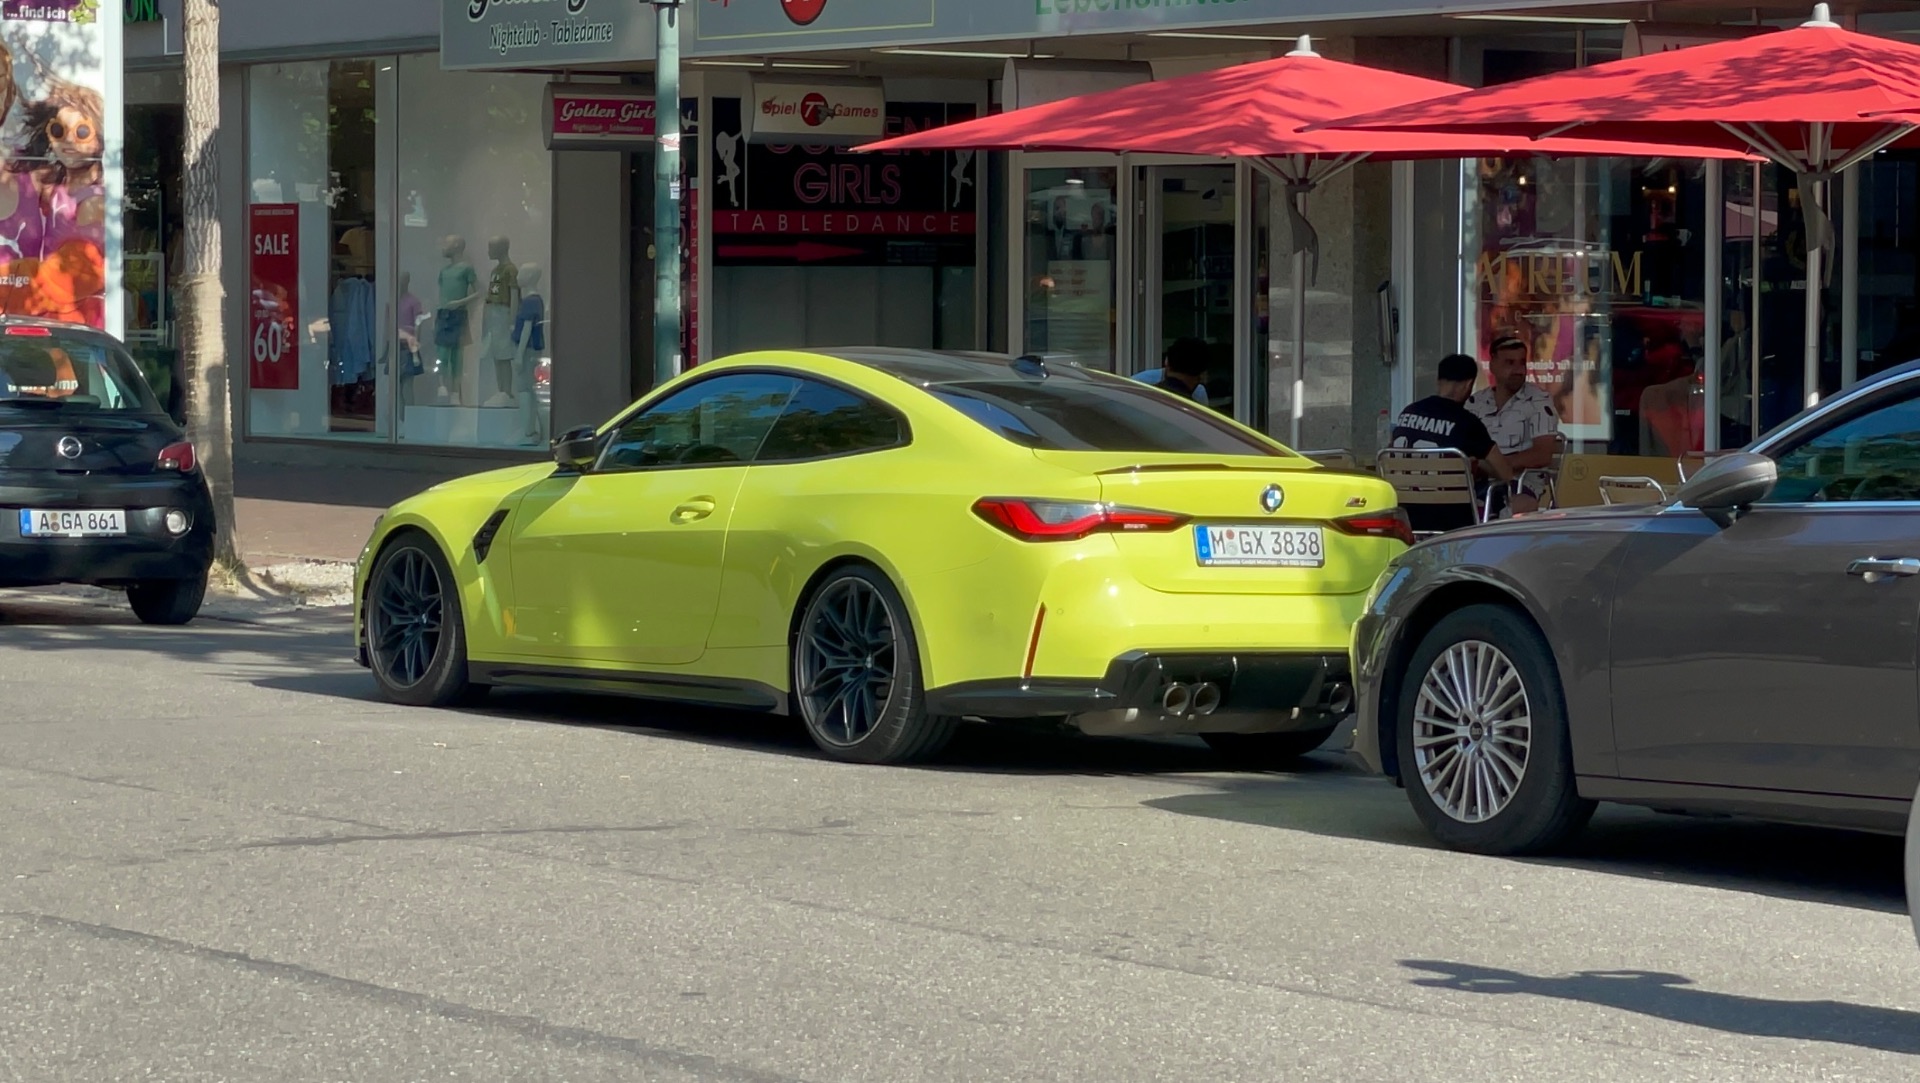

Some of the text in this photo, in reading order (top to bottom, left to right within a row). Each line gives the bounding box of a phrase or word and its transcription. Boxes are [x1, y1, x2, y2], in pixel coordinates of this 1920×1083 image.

[47, 7, 66, 19] ich
[490, 21, 540, 54] Nightclub
[551, 18, 613, 43] Tabledance
[560, 101, 656, 122] Golden Girls
[761, 98, 797, 116] Spiel
[833, 103, 879, 118] Games
[793, 163, 901, 204] GIRLS
[731, 213, 959, 232] TABLEDANCE
[255, 233, 289, 255] SALE
[0, 274, 30, 288] züge
[1398, 413, 1456, 436] GERMANY
[40, 513, 119, 530] A GA 861
[1210, 530, 1320, 556] M GX 3838
